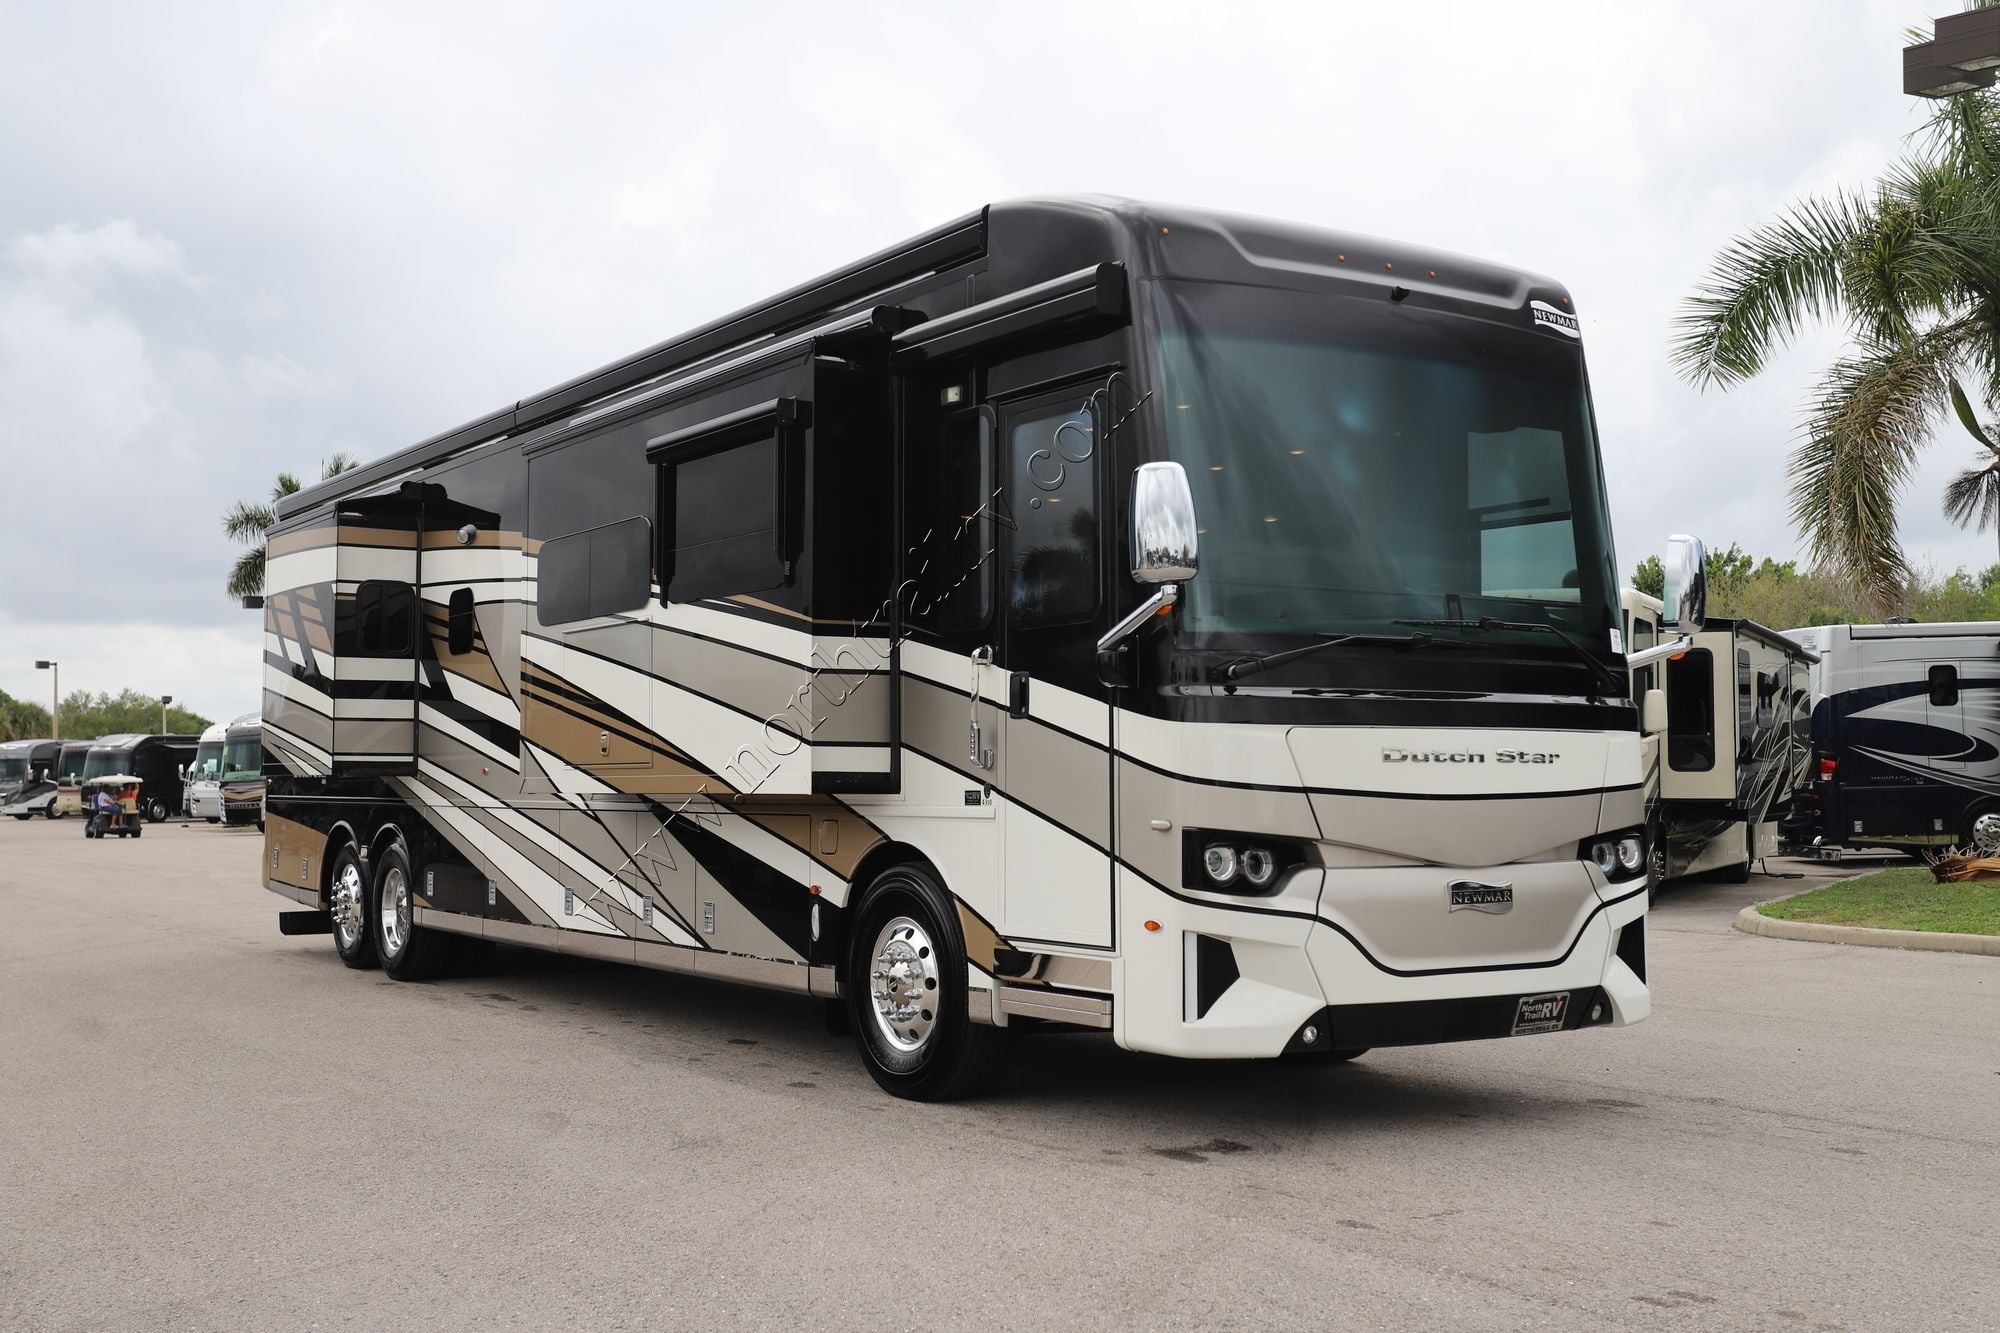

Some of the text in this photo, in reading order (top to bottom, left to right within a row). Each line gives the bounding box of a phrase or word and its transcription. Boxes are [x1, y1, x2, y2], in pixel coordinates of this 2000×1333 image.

[1533, 309, 1579, 330] NEWMAR
[1382, 747, 1561, 764] Dutch Star
[1452, 890, 1512, 904] NEWMAR
[1521, 1003, 1543, 1013] North
[1524, 1011, 1542, 1020] Trail
[1541, 1001, 1563, 1018] RV
